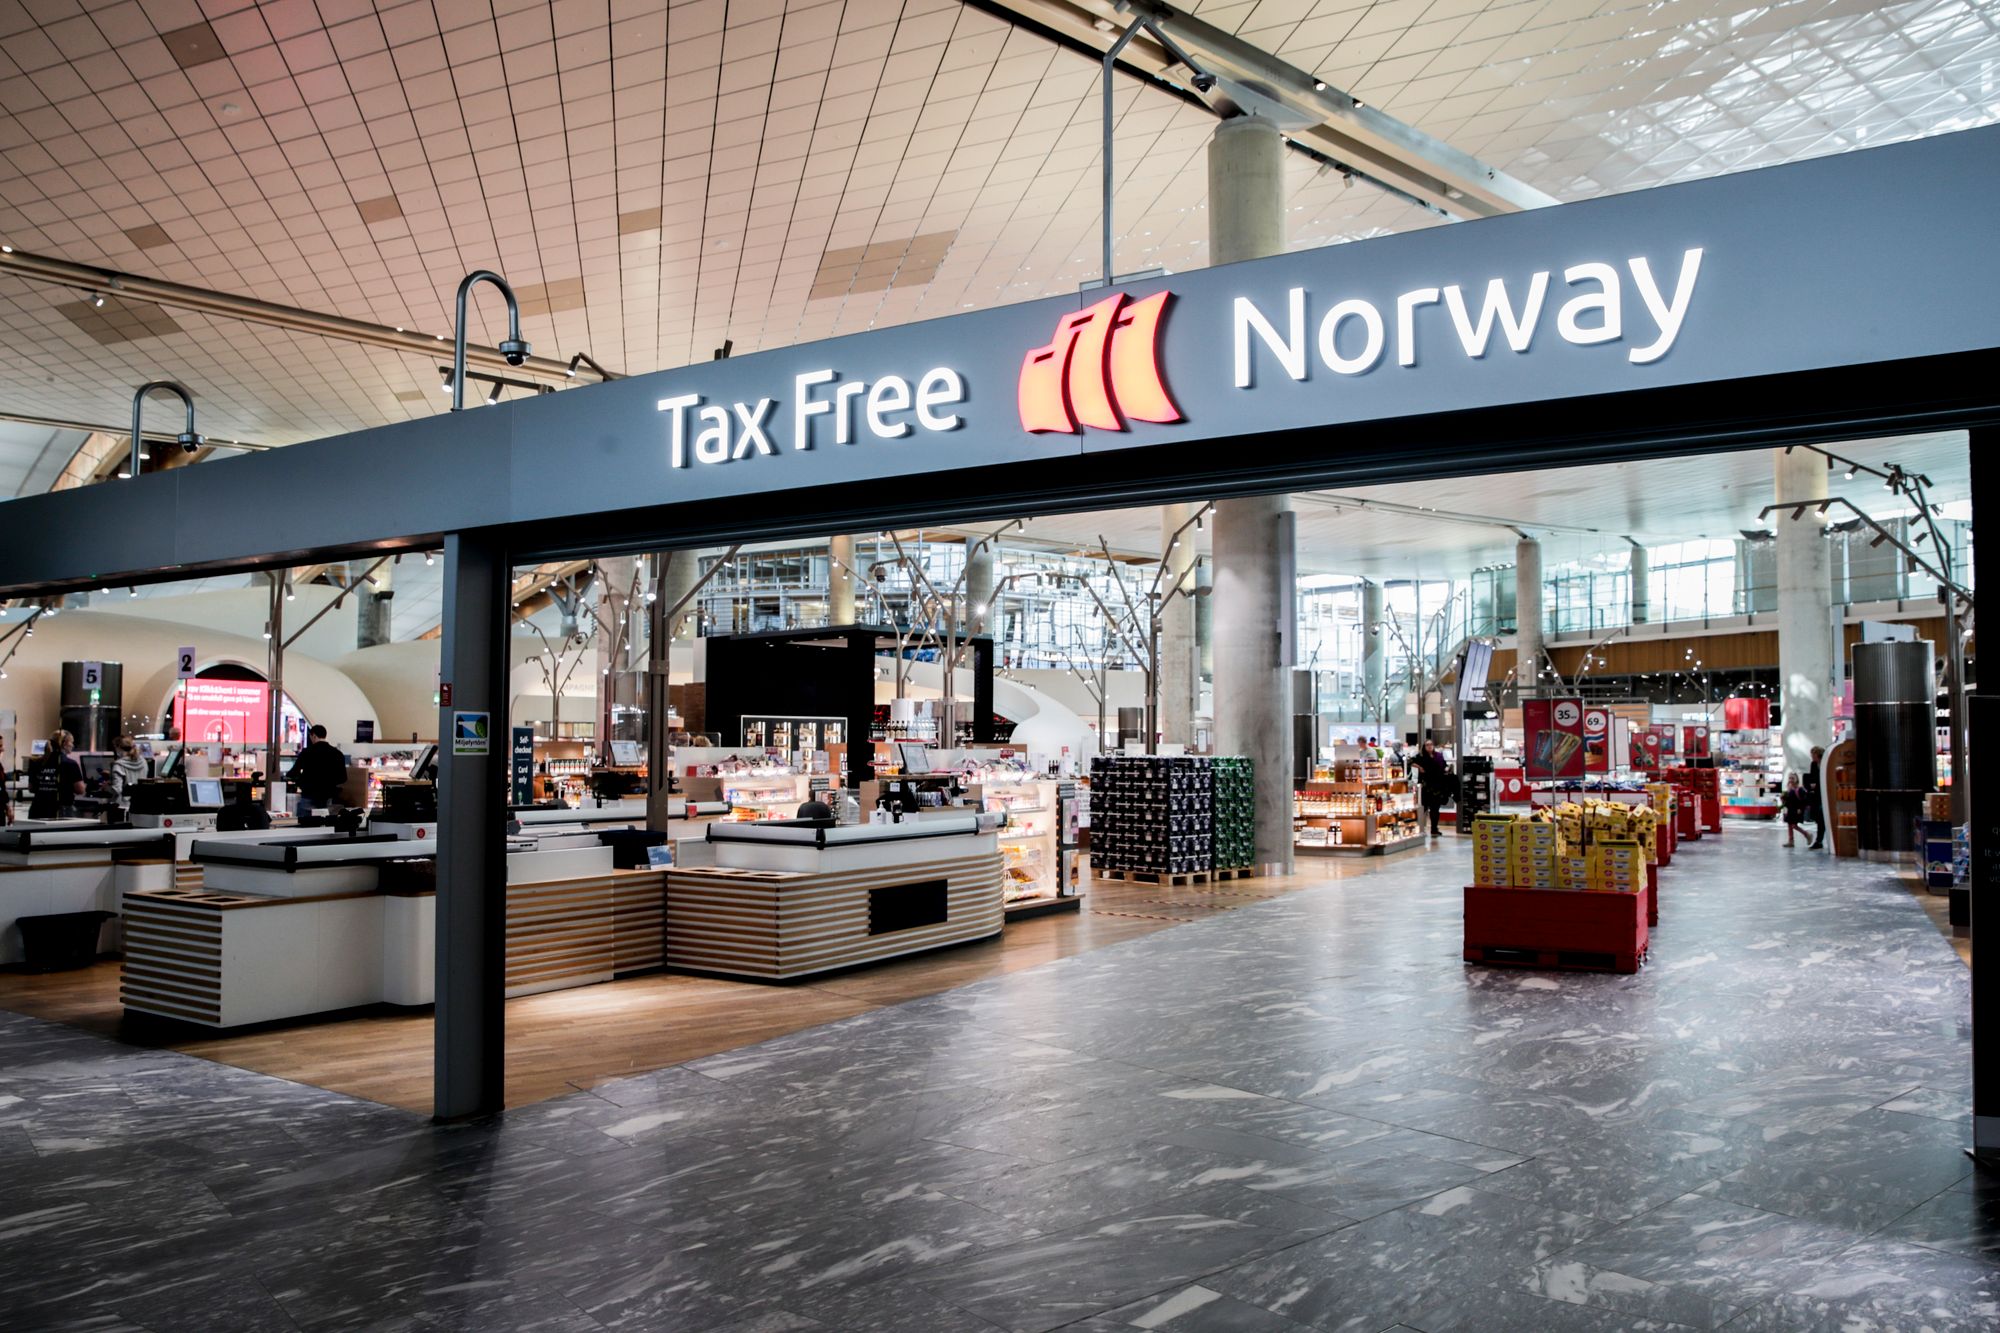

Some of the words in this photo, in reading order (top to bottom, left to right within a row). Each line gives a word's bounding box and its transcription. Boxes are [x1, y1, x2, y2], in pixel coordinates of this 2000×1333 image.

[657, 393, 774, 469] Tax
[795, 366, 967, 451] Free
[1234, 247, 1704, 389] Norway
[181, 654, 192, 672] 2
[86, 669, 97, 684] 5
[1557, 710, 1570, 720] 35
[1587, 718, 1600, 726] 69
